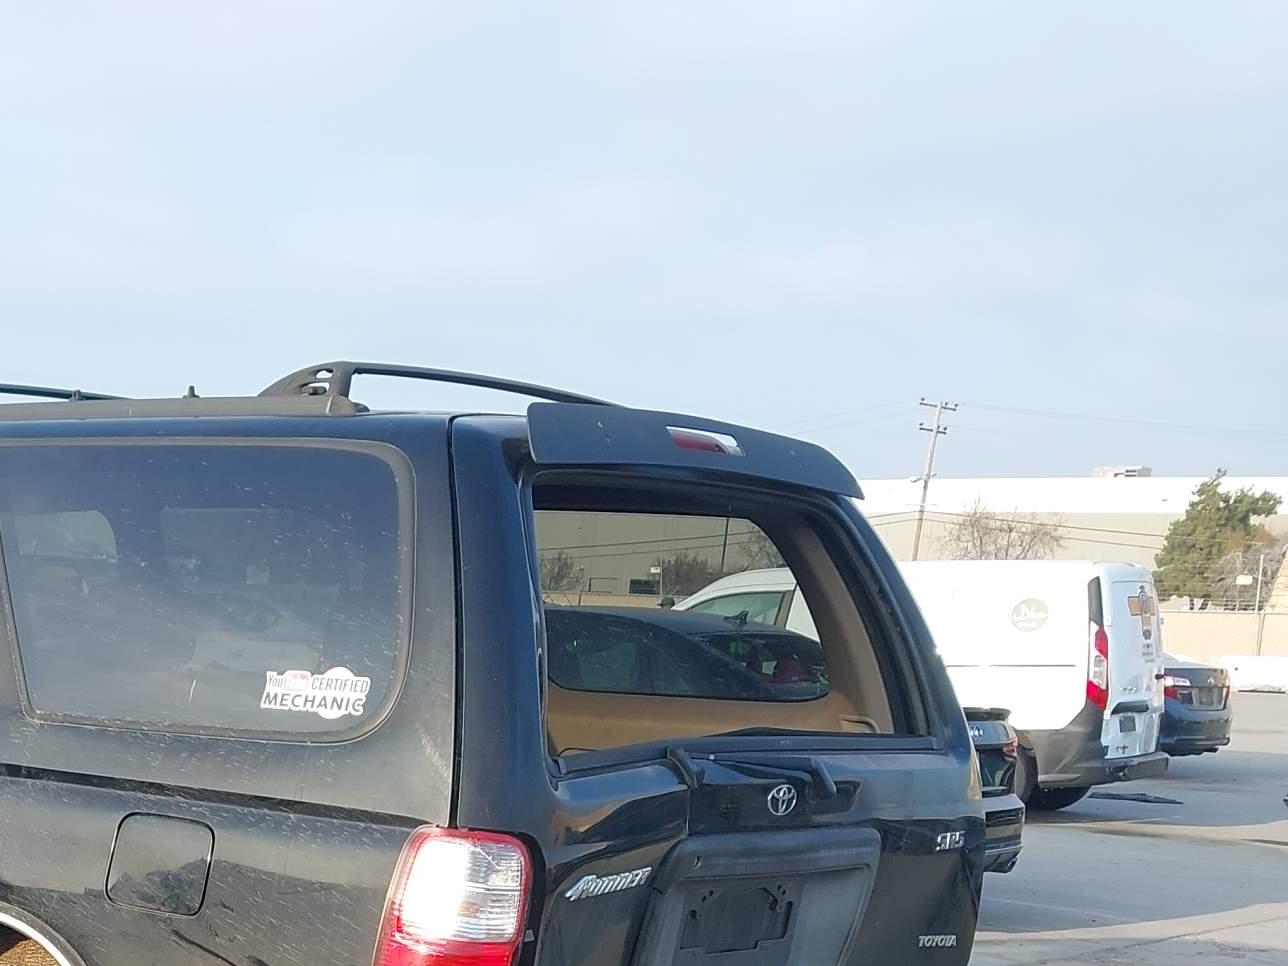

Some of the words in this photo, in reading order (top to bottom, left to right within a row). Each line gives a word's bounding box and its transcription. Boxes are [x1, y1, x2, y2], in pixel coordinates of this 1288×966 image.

[312, 676, 370, 694] CERTIFIED
[262, 691, 365, 713] MECHANIC
[918, 934, 957, 948] TOYOTA
